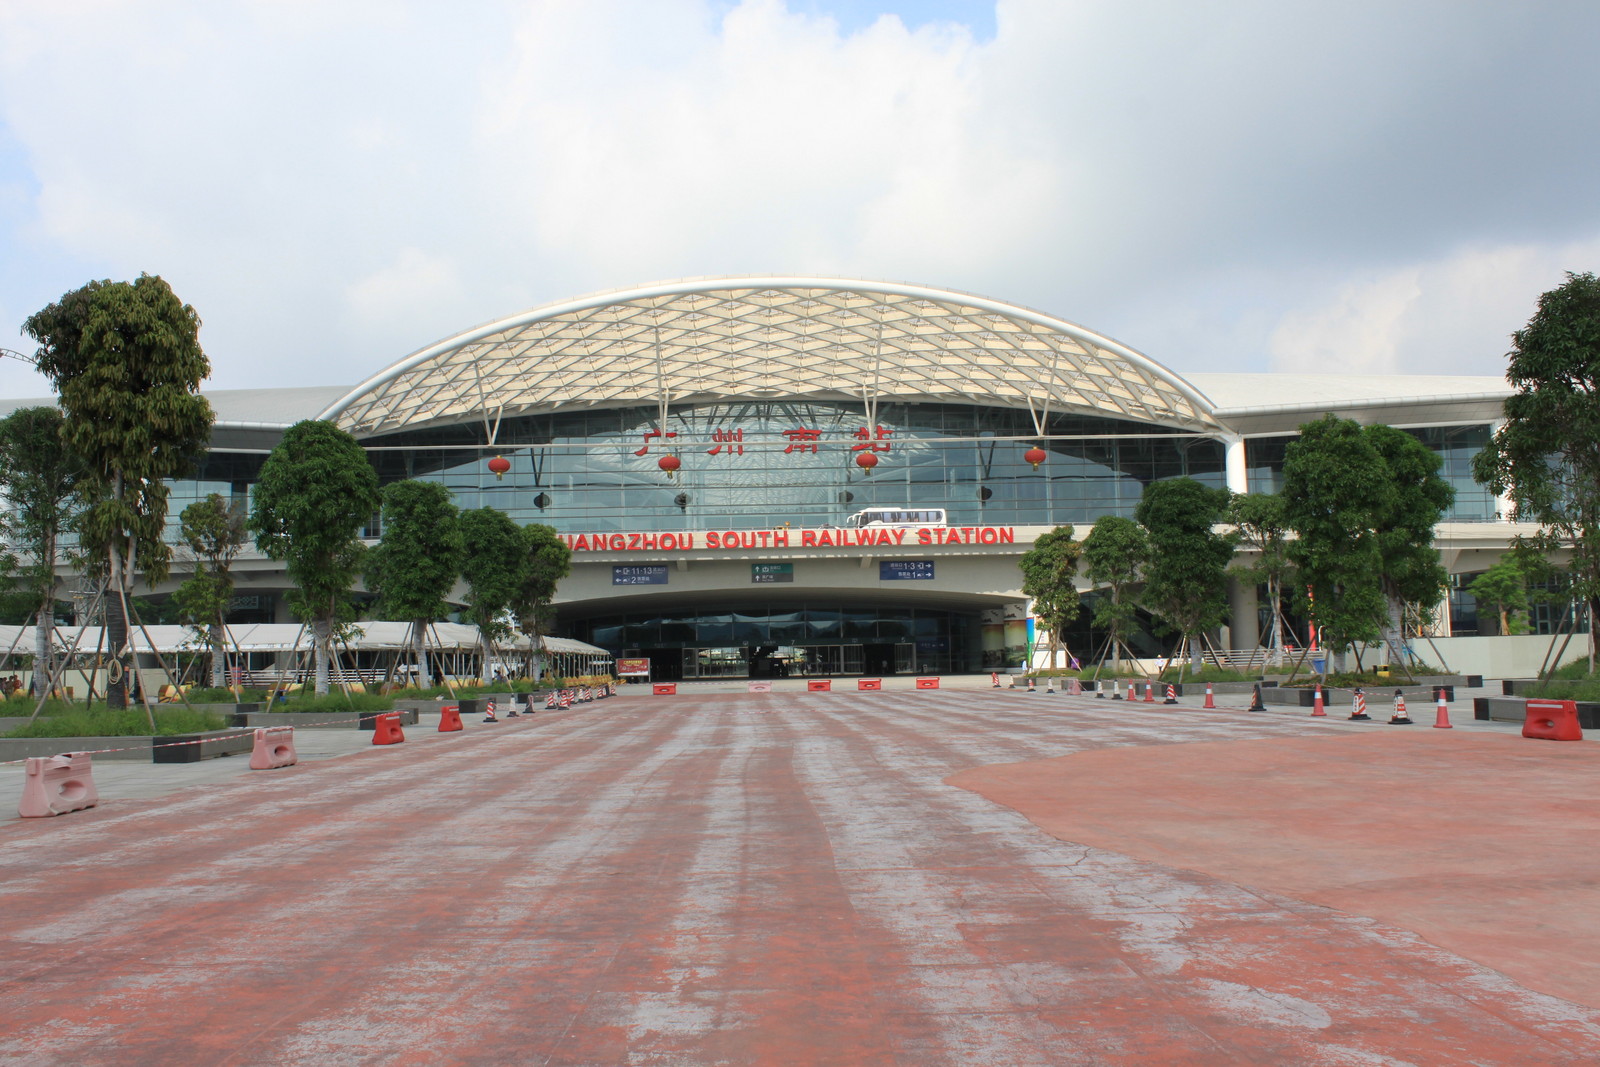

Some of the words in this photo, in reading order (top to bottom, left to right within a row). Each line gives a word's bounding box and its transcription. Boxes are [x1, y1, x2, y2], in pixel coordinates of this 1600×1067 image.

[634, 426, 894, 456] 广州南站
[558, 532, 694, 551] UANGZHOU
[705, 530, 789, 549] SOUTH
[801, 528, 906, 547] RAILWAY
[917, 526, 1014, 545] STATION
[631, 576, 637, 584] 2
